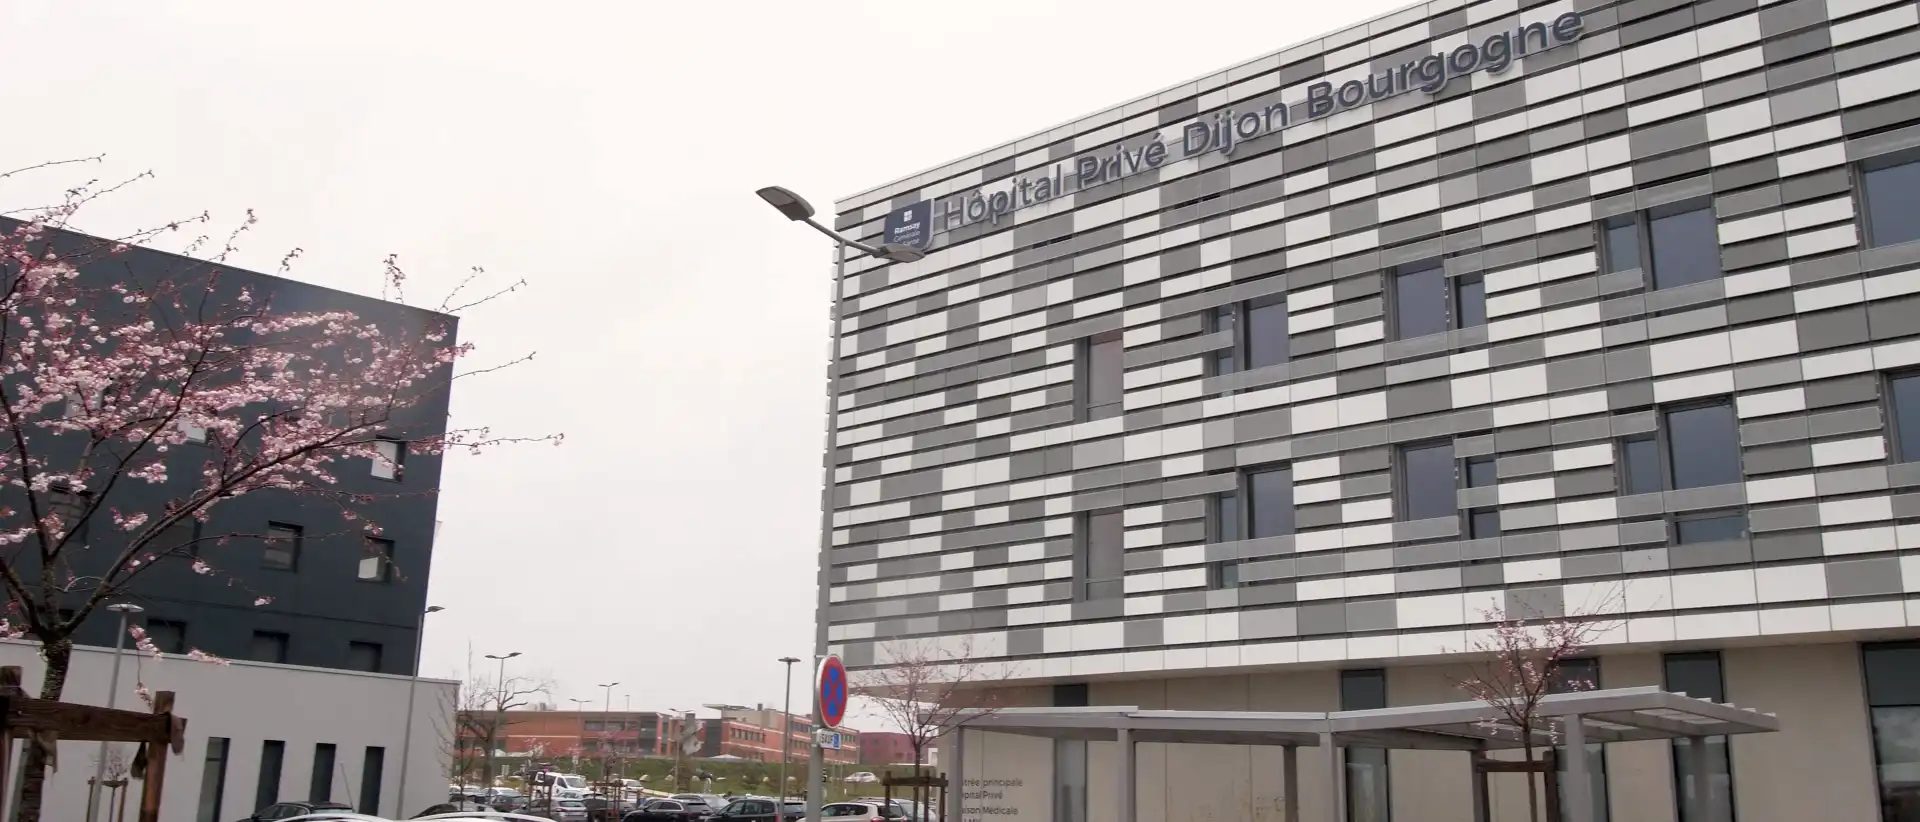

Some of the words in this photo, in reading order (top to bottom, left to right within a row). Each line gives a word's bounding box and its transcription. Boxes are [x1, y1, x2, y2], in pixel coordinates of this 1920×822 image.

[944, 163, 1064, 226] Hôpital
[1077, 131, 1169, 191] Privé
[1183, 99, 1292, 157] Dijon
[1307, 11, 1585, 119] Bourgogne
[894, 222, 920, 234] Ramsay
